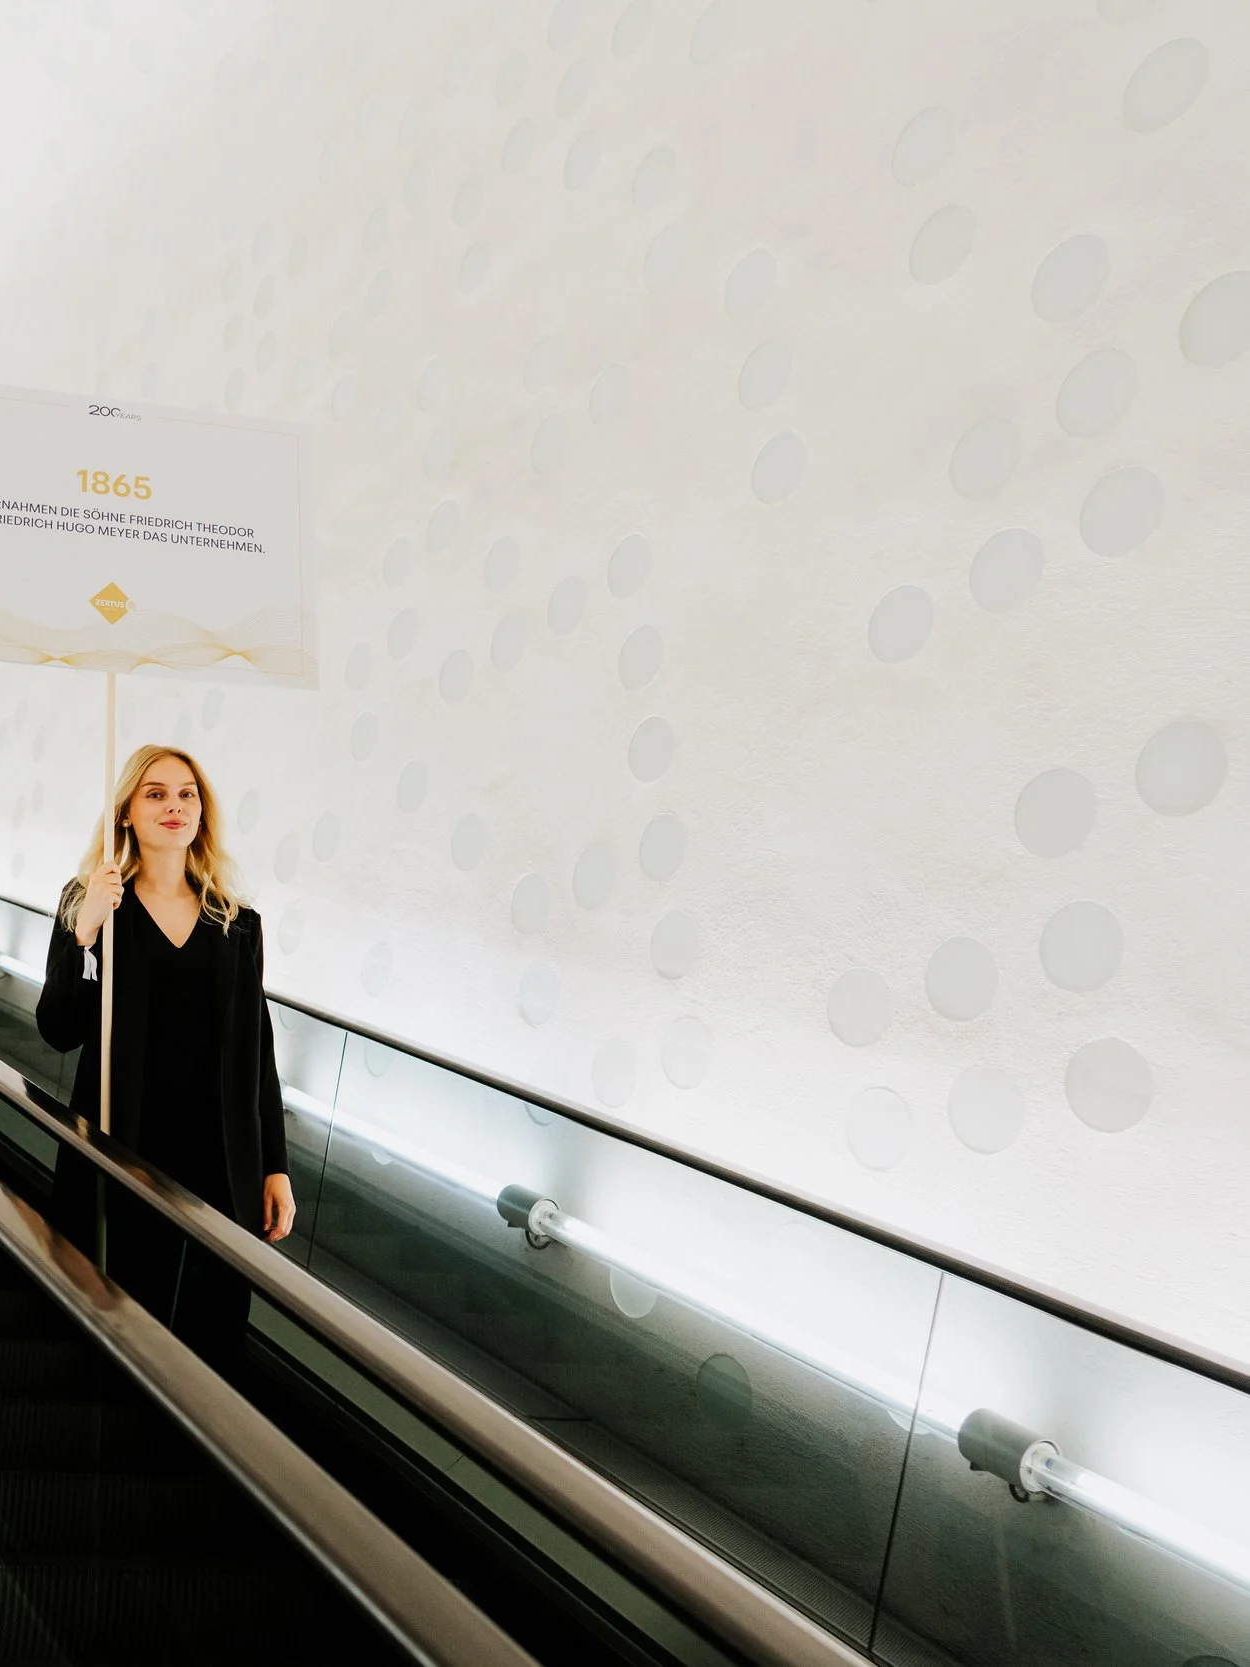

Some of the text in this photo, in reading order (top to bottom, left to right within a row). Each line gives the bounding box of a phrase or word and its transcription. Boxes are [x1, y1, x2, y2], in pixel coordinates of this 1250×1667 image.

[76, 469, 153, 501] 1865
[56, 520, 95, 534] HUGO
[97, 524, 140, 540] MEYER
[143, 530, 168, 543] DAS
[171, 533, 266, 554] UNTERNEHMEN.
[60, 506, 80, 518] DIE
[83, 507, 126, 524] SÖHNE
[129, 514, 193, 531] FRIEDRICH
[196, 522, 255, 539] THEODOR
